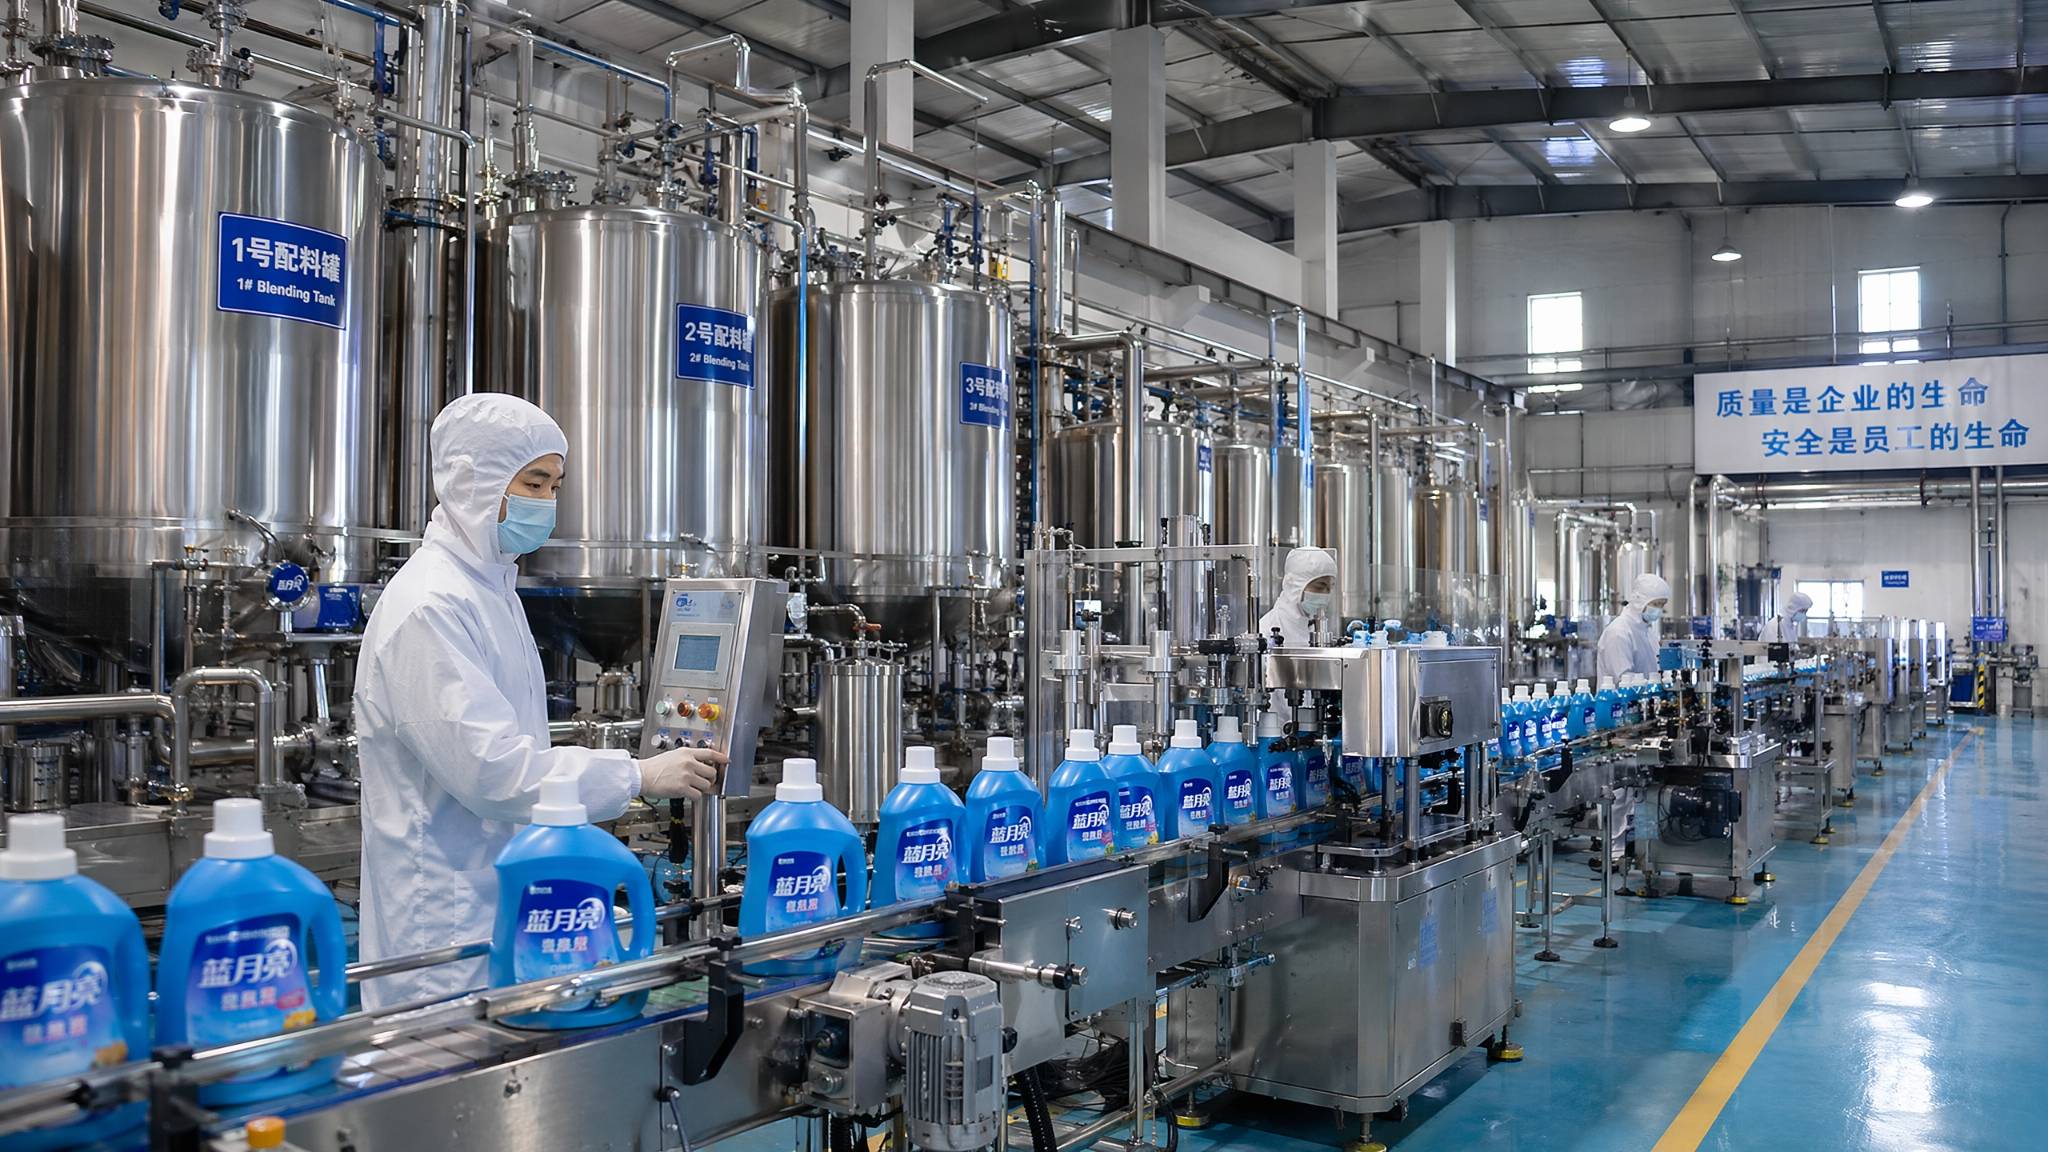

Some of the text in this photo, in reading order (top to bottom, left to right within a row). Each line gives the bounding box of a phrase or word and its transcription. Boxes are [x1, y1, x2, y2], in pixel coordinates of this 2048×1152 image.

[231, 237, 340, 283] 1号配料罐
[237, 278, 336, 306] 1# Blending Tank
[704, 354, 736, 370] Blending
[1717, 377, 1988, 417] 质量是企业的生命
[1762, 419, 2029, 457] 安全是员工的生命
[989, 822, 1029, 844] 蓝月亮
[1072, 810, 1108, 830] 蓝月亮
[901, 841, 949, 864] 蓝月亮
[772, 871, 828, 896] 蓝月亮
[523, 905, 601, 933] 蓝月亮
[197, 946, 293, 988] 蓝月亮
